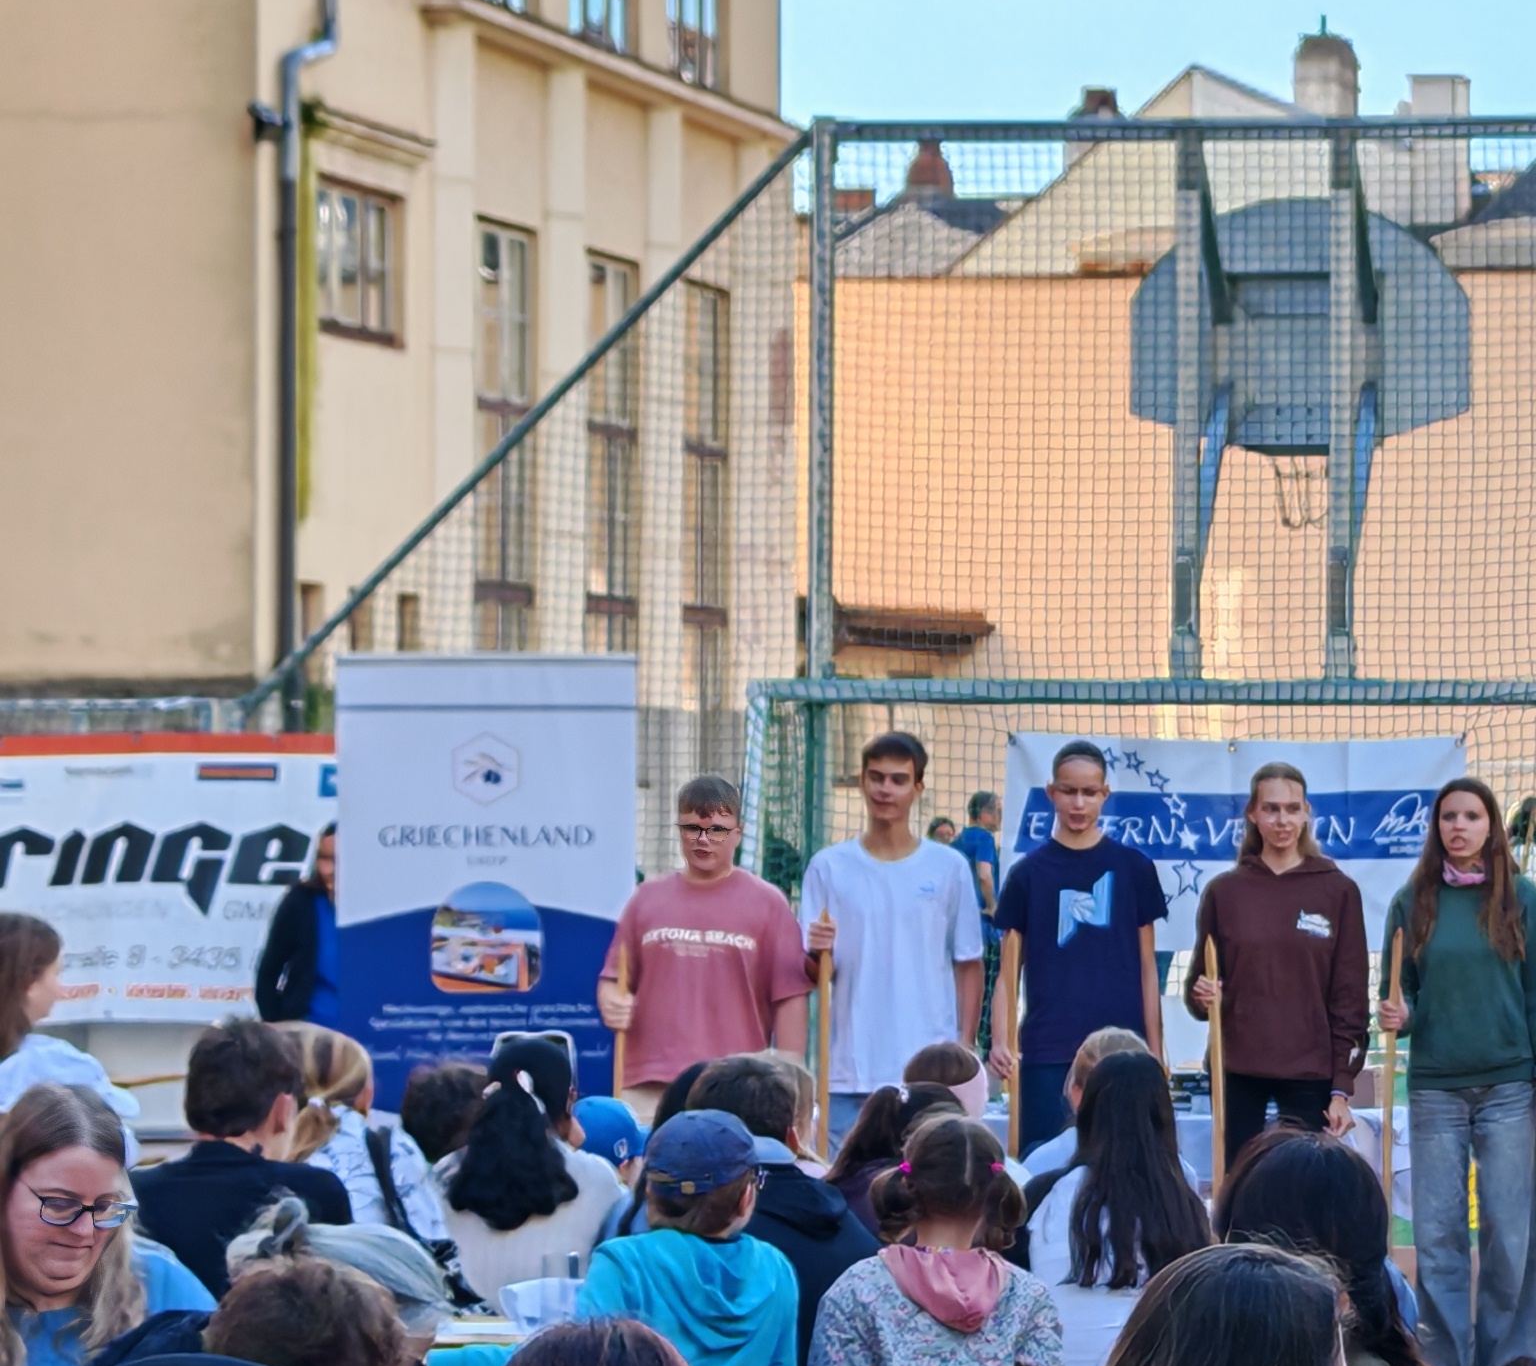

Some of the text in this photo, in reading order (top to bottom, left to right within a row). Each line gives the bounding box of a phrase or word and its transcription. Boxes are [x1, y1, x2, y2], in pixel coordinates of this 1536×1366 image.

[377, 824, 597, 849] GRIECHENLAND
[1027, 811, 1177, 846] EERN
[1205, 816, 1356, 847] VEIN
